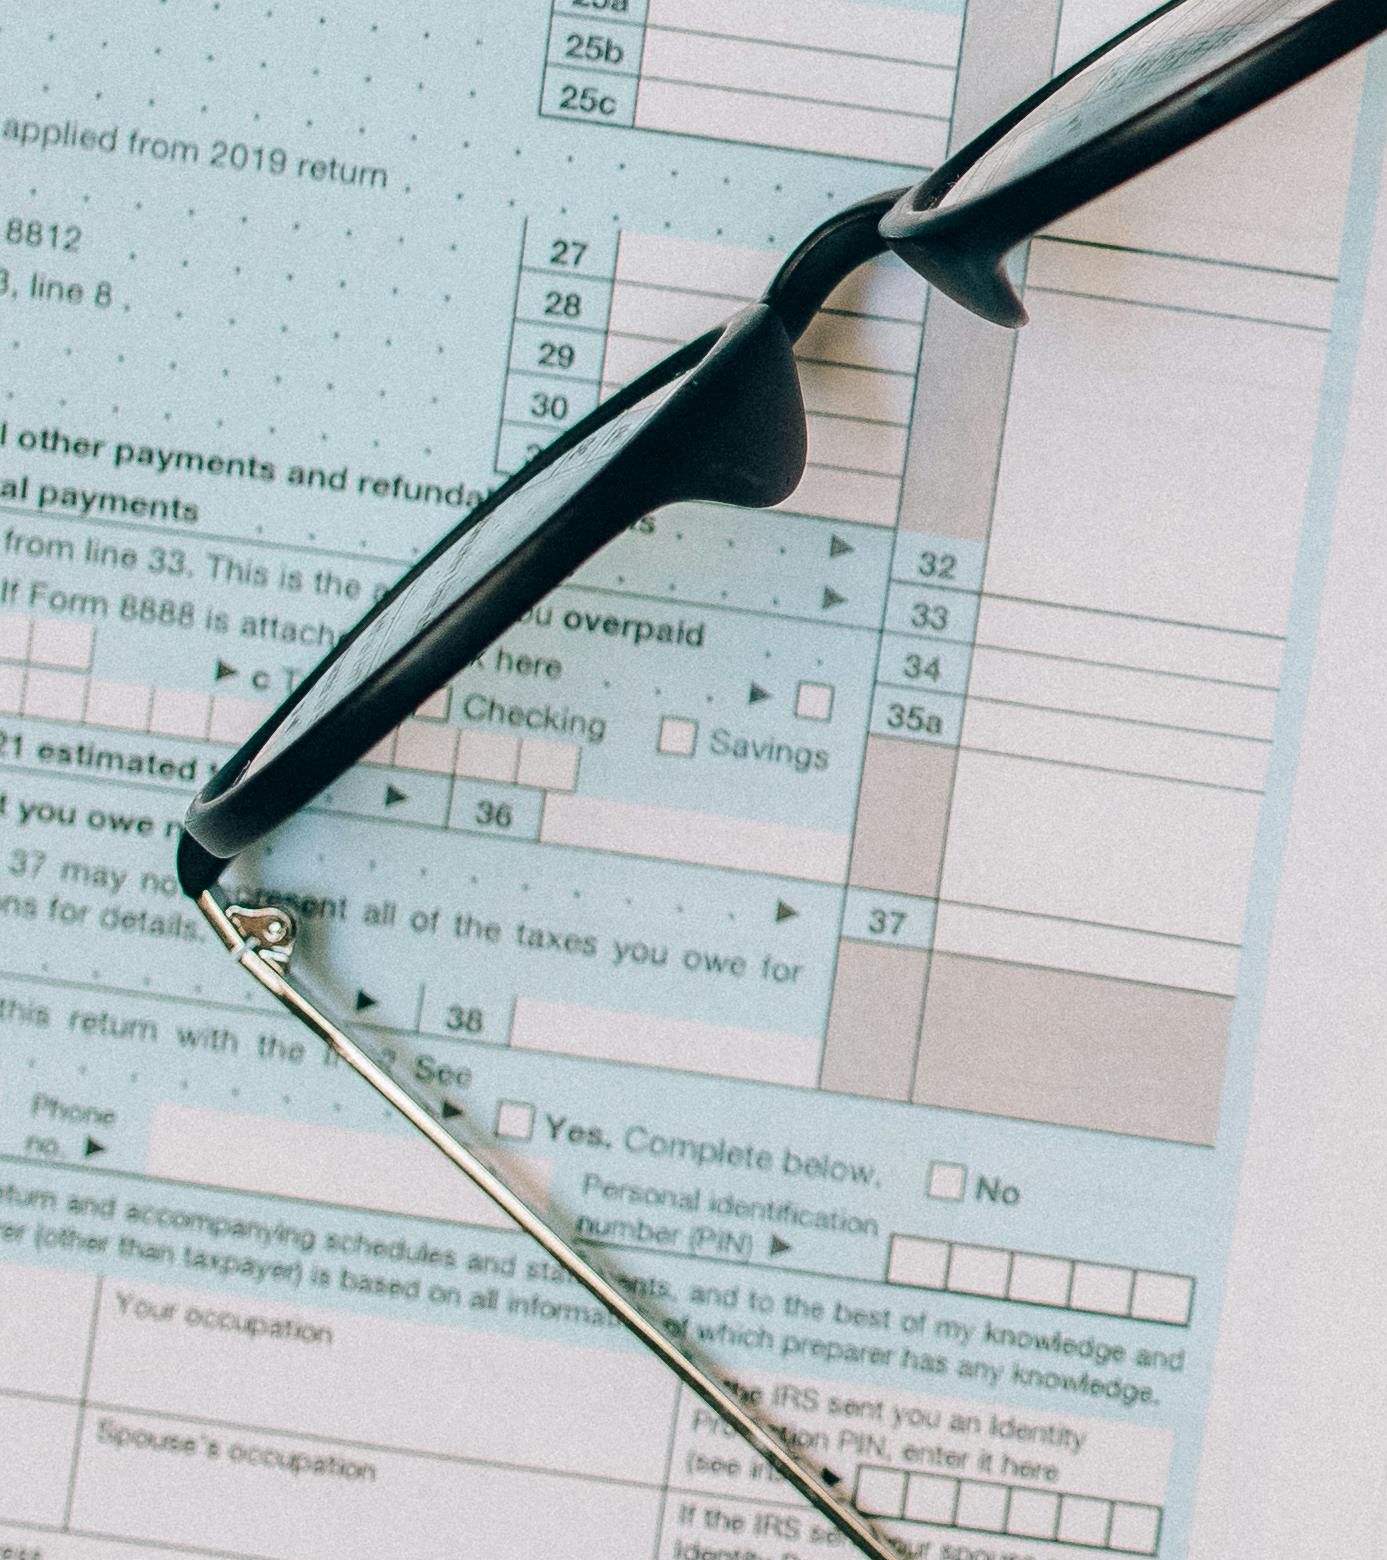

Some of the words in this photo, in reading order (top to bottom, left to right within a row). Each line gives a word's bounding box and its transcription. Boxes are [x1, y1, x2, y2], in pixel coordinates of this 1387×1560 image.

[565, 34, 625, 64] 25b
[559, 85, 618, 115] 25c
[3, 119, 118, 153] applied
[129, 130, 199, 162] from
[210, 141, 287, 174] 2019
[298, 158, 387, 187] return
[6, 219, 81, 251] 8812
[549, 240, 588, 266] 27
[30, 273, 83, 303] line
[95, 282, 111, 307] 8
[544, 291, 582, 318] 28
[537, 343, 575, 369] 29
[530, 393, 569, 420] 30
[18, 429, 103, 457] other
[114, 444, 274, 480] payments
[288, 467, 348, 490] and
[359, 477, 492, 510] refunda
[38, 486, 198, 522] payments
[5, 528, 74, 560] from
[85, 538, 137, 569] line
[148, 546, 193, 577] 33.
[208, 553, 268, 587] This
[279, 571, 302, 592] is
[314, 571, 361, 600] the
[918, 552, 956, 579] 32
[29, 581, 108, 616] Form
[120, 596, 194, 625] 8888
[205, 609, 229, 633] is
[911, 602, 948, 631] 33
[563, 611, 704, 647] overpaid
[496, 648, 561, 678] here
[904, 654, 940, 681] 34
[462, 693, 606, 744] Checking
[887, 703, 942, 734] 35a
[38, 744, 197, 781] estimated
[710, 728, 828, 773] Savings
[19, 802, 76, 826] you
[88, 812, 153, 835] owe
[476, 801, 512, 828] 36
[61, 862, 127, 895] may
[49, 896, 89, 924] for
[101, 909, 212, 941] details.
[869, 909, 907, 935] 37
[363, 902, 396, 925] all
[410, 910, 440, 933] of
[454, 915, 501, 942] the
[517, 924, 596, 956] taxes
[613, 941, 668, 966] you
[683, 951, 746, 976] owe
[762, 955, 803, 984] for
[446, 1006, 482, 1033] 38
[69, 1011, 157, 1041] return
[177, 1029, 238, 1051] with
[258, 1035, 305, 1063] the
[32, 1094, 116, 1126] Phone
[546, 1114, 611, 1149] Yes.
[624, 1126, 773, 1170] Complete
[782, 1148, 880, 1187] below.
[582, 1173, 701, 1212] Personal
[709, 1195, 878, 1236] identification
[975, 1177, 1020, 1205] No
[572, 1215, 677, 1242] number
[689, 1228, 755, 1259] (PIN)
[117, 1292, 176, 1321] Your
[184, 1307, 333, 1343] occupation
[690, 1286, 739, 1308] and
[748, 1291, 774, 1314] to
[784, 1295, 824, 1320] the
[833, 1302, 891, 1329] best
[984, 1322, 1126, 1366] knowledge
[1135, 1349, 1185, 1372] and
[901, 1348, 947, 1374] has
[829, 1397, 883, 1419] sent
[892, 1406, 941, 1429] you
